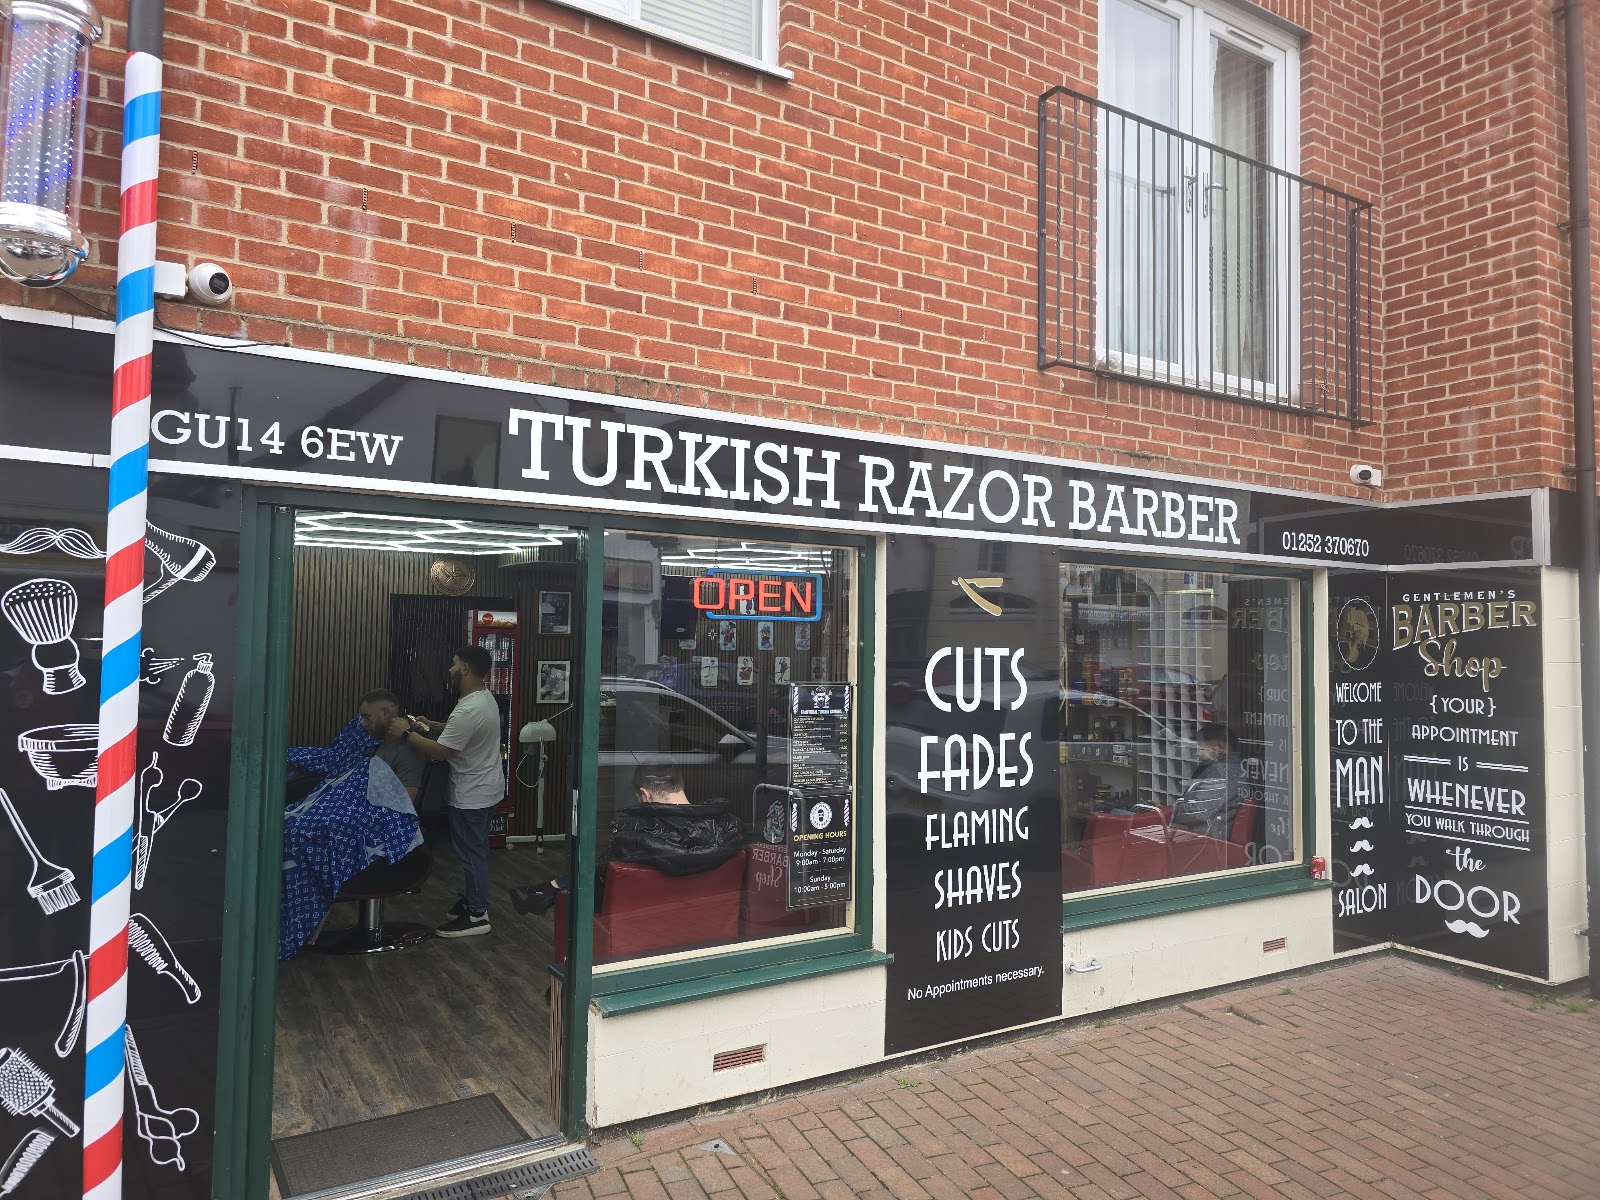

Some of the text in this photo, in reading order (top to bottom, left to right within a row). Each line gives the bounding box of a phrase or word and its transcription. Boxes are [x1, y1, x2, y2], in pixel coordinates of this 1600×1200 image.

[151, 409, 404, 466] GU14 6EW
[508, 408, 1241, 545] TURKISH RAZOR BARBER
[1282, 531, 1370, 557] 01252 370670
[693, 577, 812, 613] OPEN
[1402, 589, 1516, 603] GENTLEMEN'S
[1392, 600, 1538, 651] BARBER
[924, 646, 1028, 713] CUTS
[1418, 638, 1508, 693] Shop
[1335, 682, 1382, 703] WELCOME
[1335, 718, 1383, 746] TO THE
[1411, 724, 1519, 747] APPOINTMENT
[917, 731, 1034, 794] FADES
[1457, 755, 1469, 772] IS
[1335, 755, 1384, 808] MAN
[1406, 777, 1526, 816] WHENEVER
[793, 830, 847, 842] OPENING HOURS
[925, 805, 1029, 851] FLAMING
[1404, 812, 1530, 843] YOU WALK THROUGH
[793, 849, 818, 858] Monday
[822, 846, 847, 855] Saturday
[1445, 845, 1487, 873] the
[809, 874, 831, 883] Sunday
[934, 860, 1022, 910] SHAVES
[1338, 882, 1387, 918] SALON
[1415, 873, 1521, 925] DOOR
[936, 918, 1020, 963] KIDS CUTS
[907, 965, 1045, 1001] No Appointments necessary.
